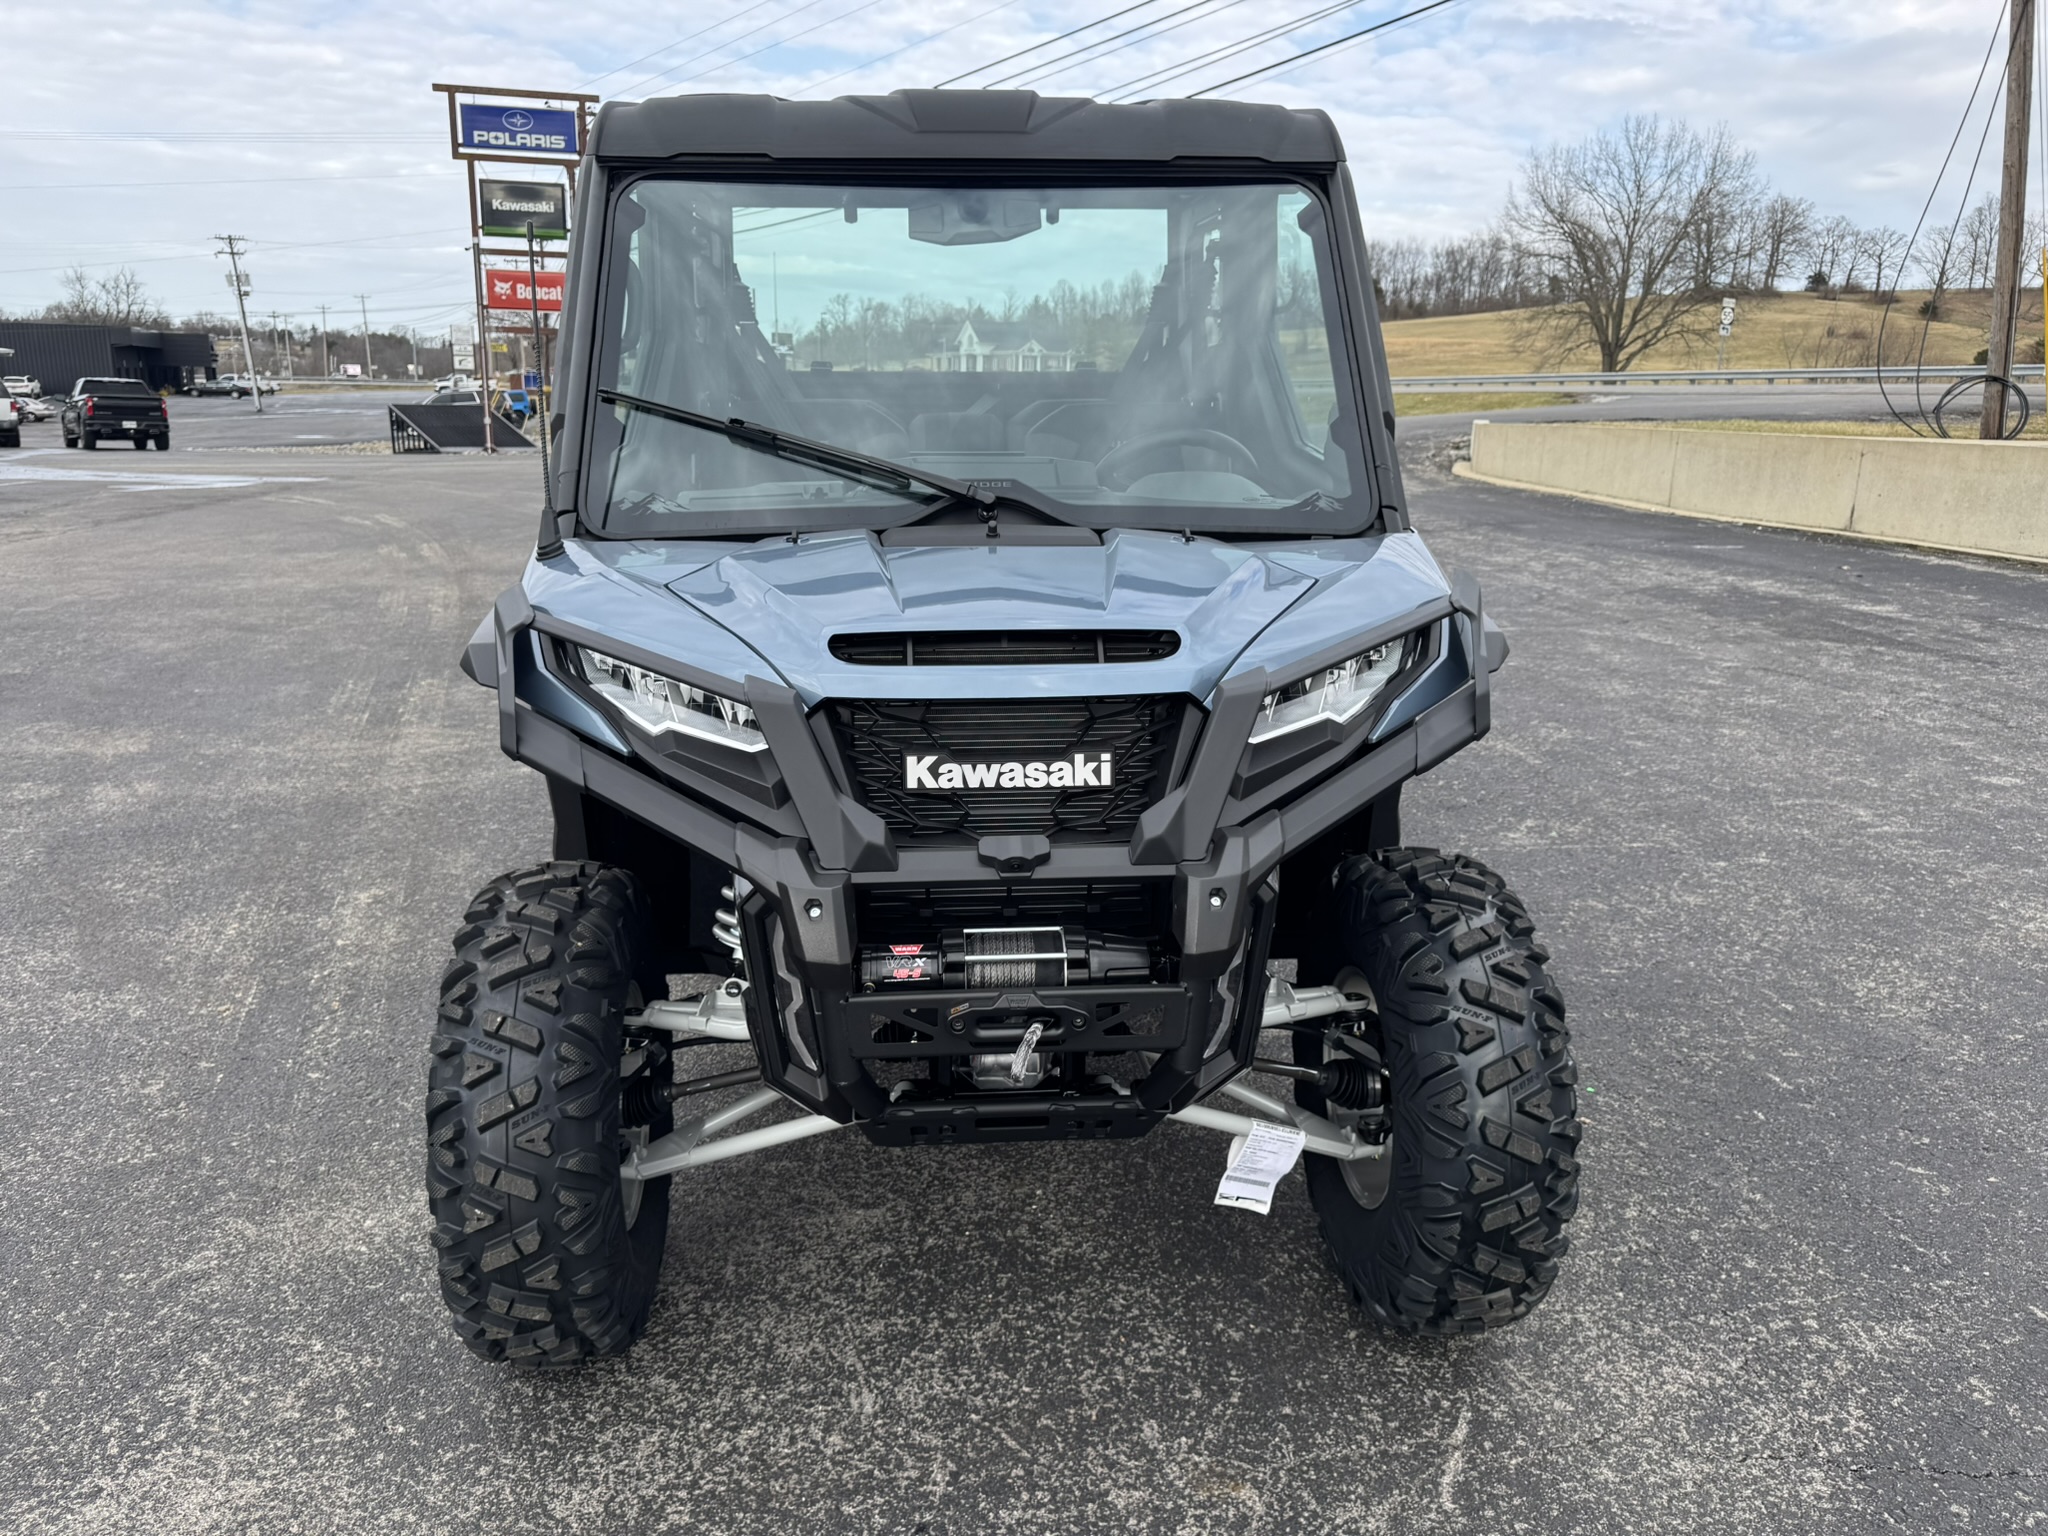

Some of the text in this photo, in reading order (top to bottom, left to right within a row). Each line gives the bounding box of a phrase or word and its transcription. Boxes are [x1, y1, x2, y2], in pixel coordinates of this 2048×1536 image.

[473, 130, 566, 149] POLARIS
[492, 199, 555, 213] Kawasaki
[906, 753, 1111, 789] Kawasaki
